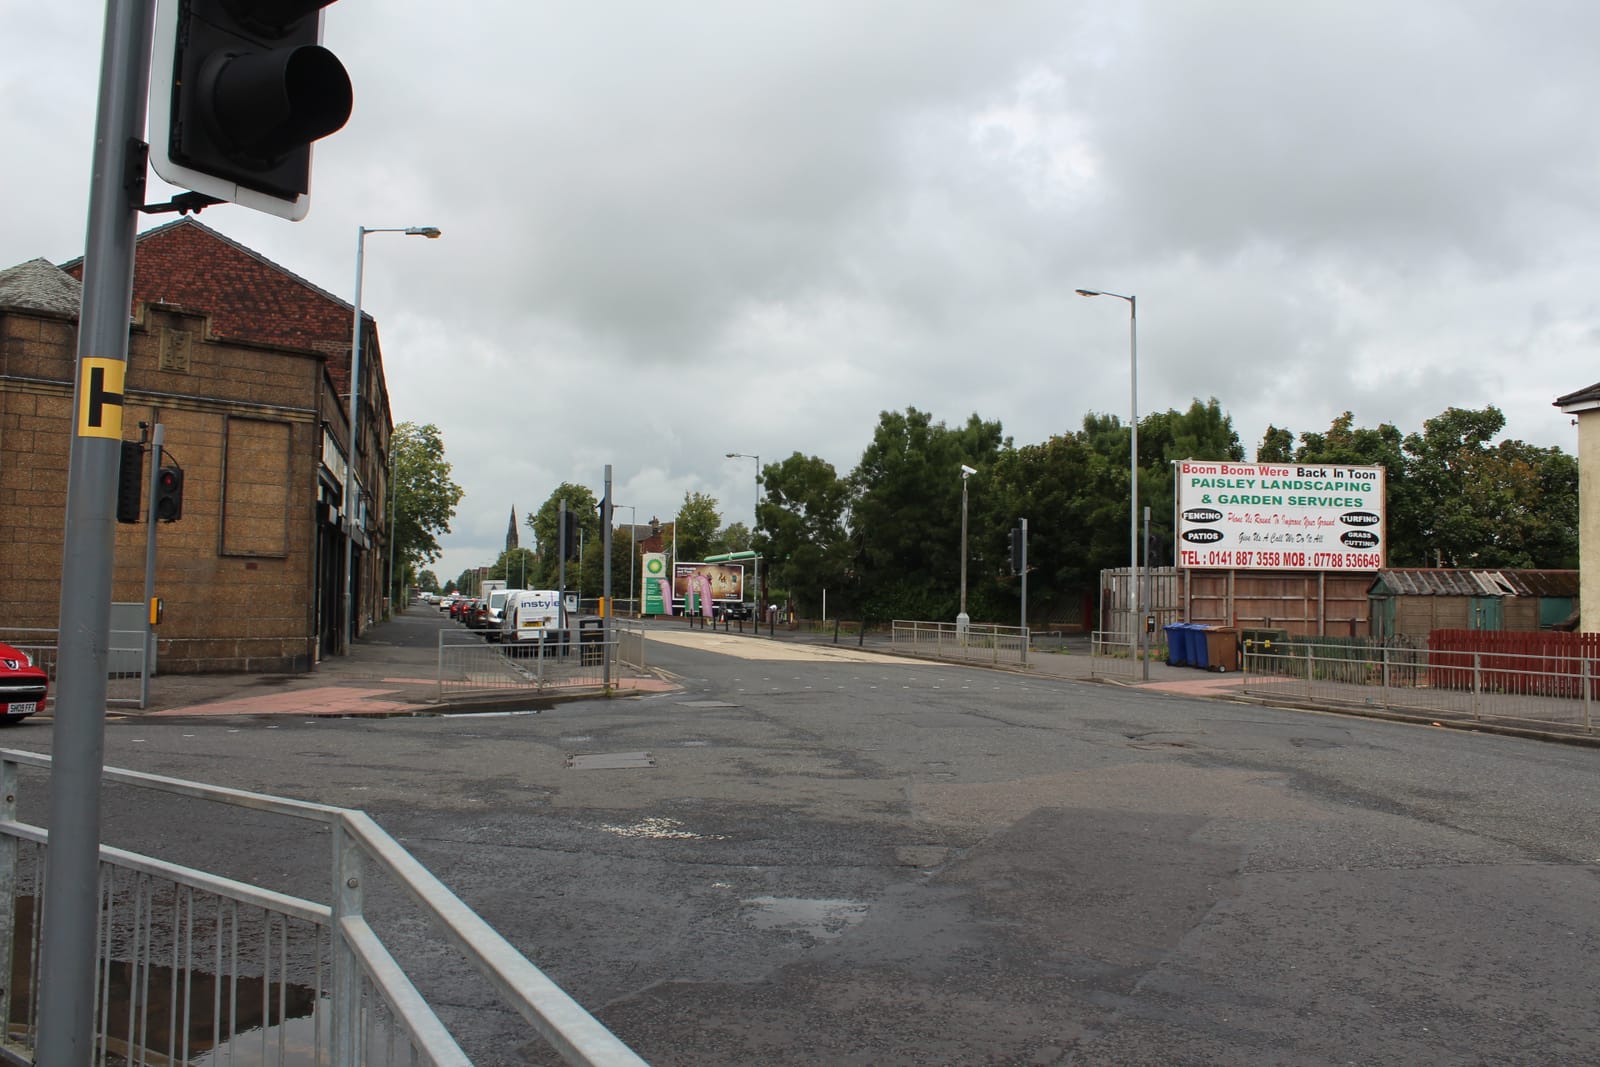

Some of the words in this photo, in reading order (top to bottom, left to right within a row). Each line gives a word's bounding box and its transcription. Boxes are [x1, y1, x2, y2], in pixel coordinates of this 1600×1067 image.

[1182, 463, 1217, 474] Boom
[1221, 465, 1255, 476] Boom
[1259, 466, 1289, 477] Were
[1297, 467, 1327, 478] Back
[1333, 468, 1344, 479] In
[1348, 469, 1376, 480] Toon
[1191, 478, 1256, 489] PAISLEY
[1261, 479, 1372, 492] LANDSCAPING
[1201, 494, 1212, 504] &
[1218, 494, 1283, 505] GARDEN
[1288, 496, 1363, 507] SERVICES
[1183, 512, 1221, 520] FENCING
[1341, 515, 1378, 523] TURFING
[1209, 551, 1232, 565] 0141
[1236, 551, 1253, 566] 887
[1256, 552, 1280, 566] 3558
[1314, 553, 1343, 567] 07788
[1346, 553, 1380, 568] 536649
[520, 593, 560, 609] instyle
